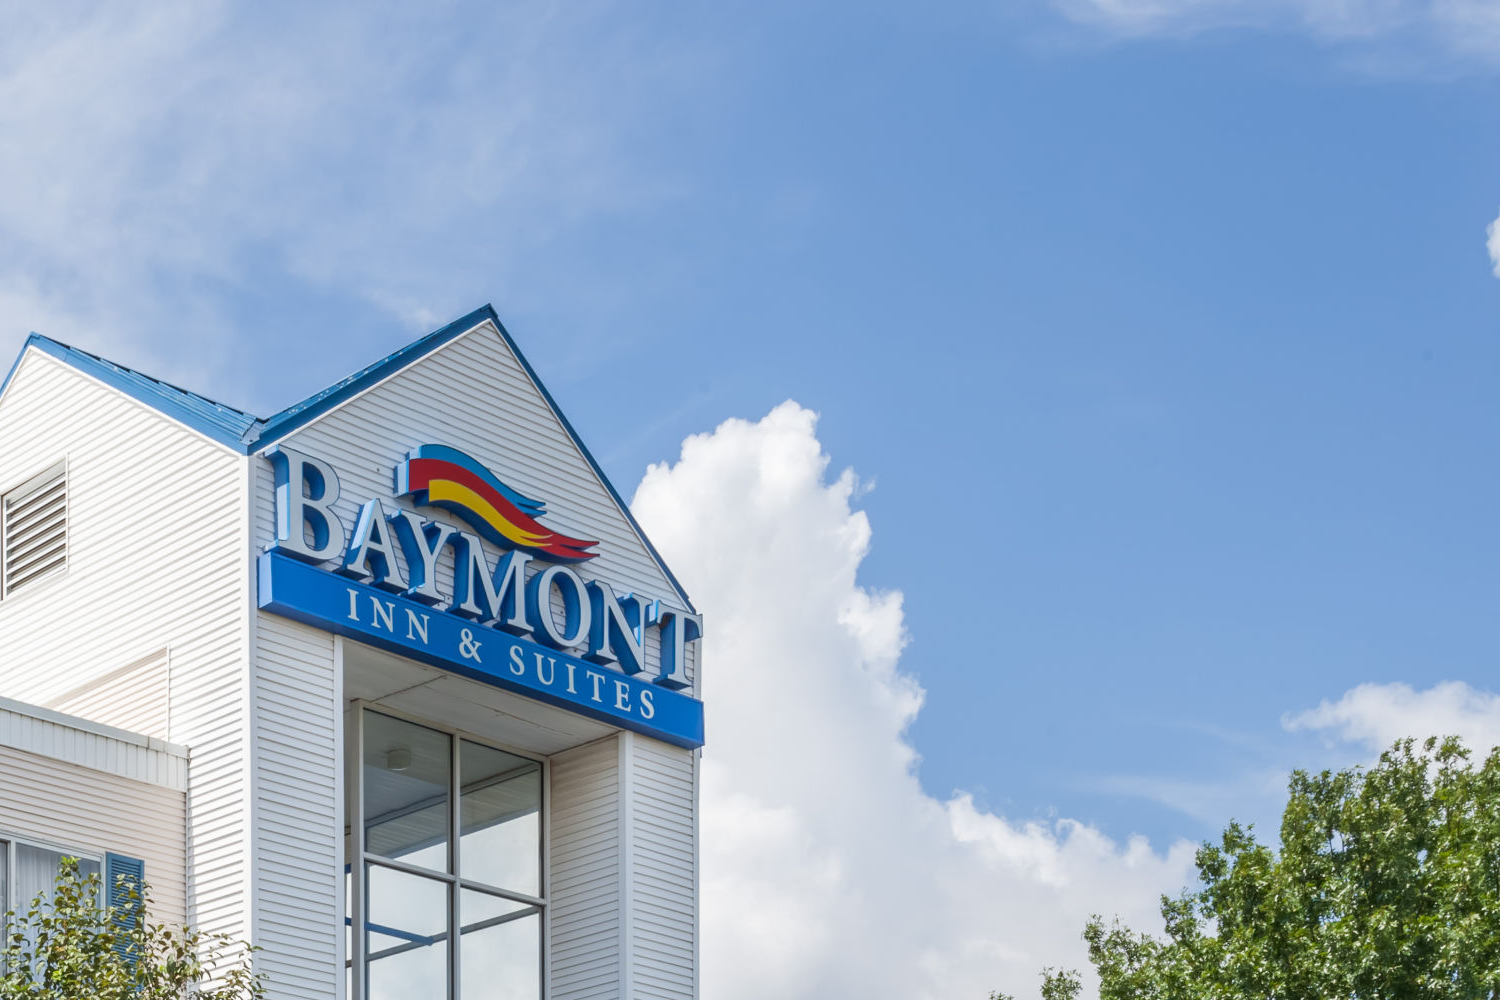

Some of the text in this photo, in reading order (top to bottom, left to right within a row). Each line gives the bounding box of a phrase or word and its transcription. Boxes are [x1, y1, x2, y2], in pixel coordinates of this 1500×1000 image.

[266, 444, 703, 689] BAYMONT
[346, 588, 655, 721] INN & SUITES
